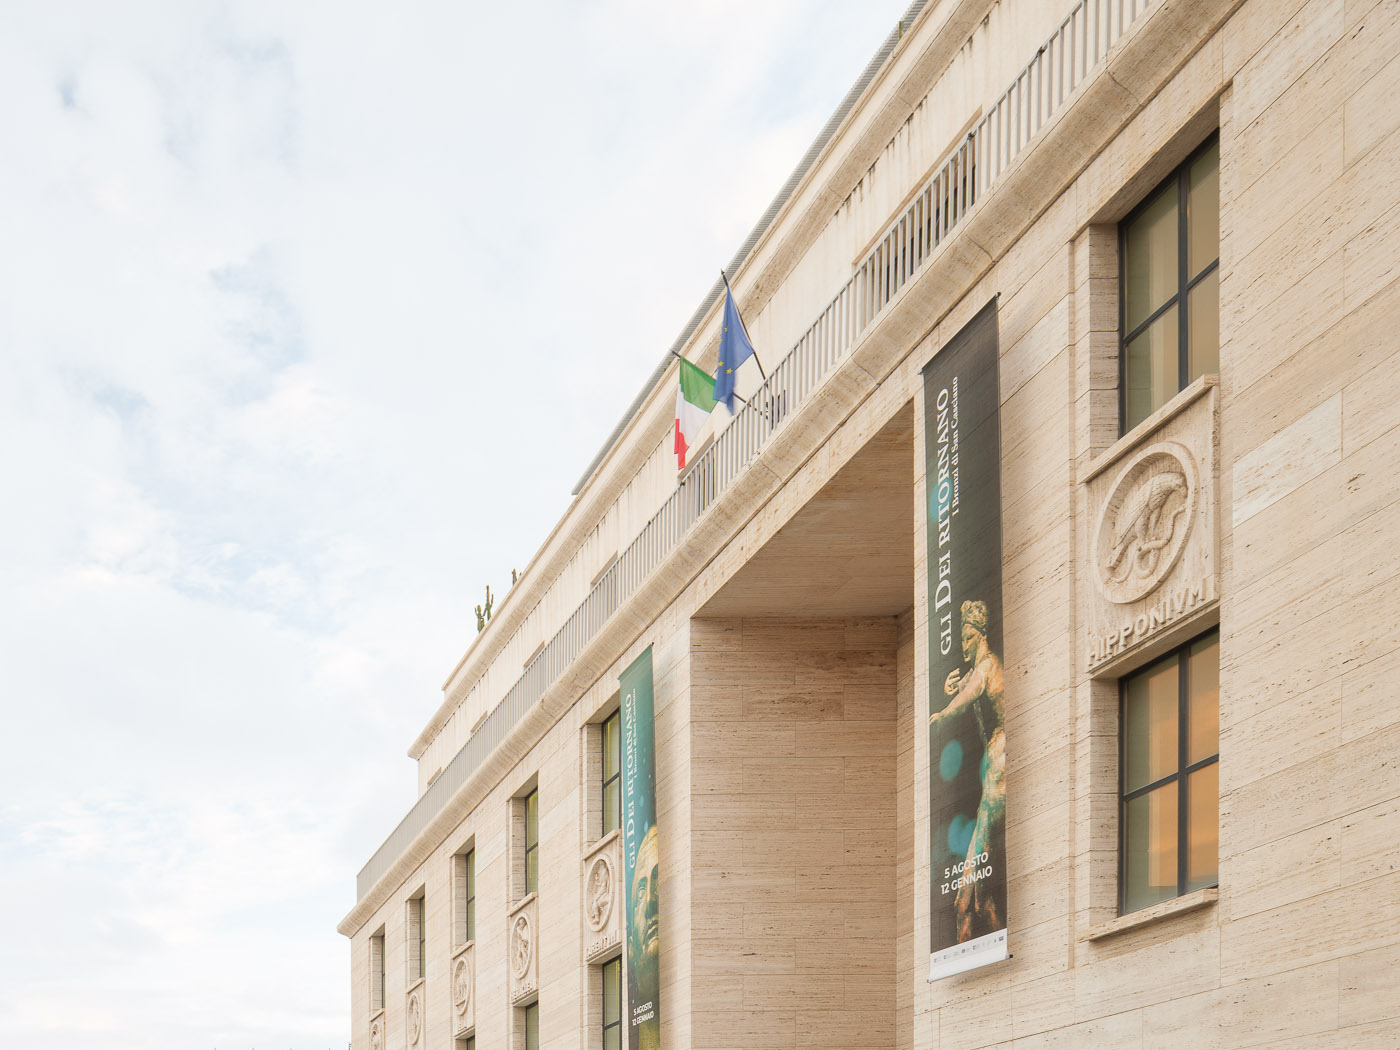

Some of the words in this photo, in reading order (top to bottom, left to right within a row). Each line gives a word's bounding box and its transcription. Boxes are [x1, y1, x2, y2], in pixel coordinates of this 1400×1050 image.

[950, 376, 959, 429] Casciano
[951, 429, 959, 453] San
[936, 387, 951, 549] RITORNANO
[951, 453, 959, 467] di
[951, 467, 960, 508] Bronzi
[940, 611, 952, 656] GLI
[625, 693, 635, 798] RITORNANO
[940, 882, 950, 895] 12
[951, 865, 993, 891] GENNAIO
[944, 867, 950, 879] 5
[951, 851, 989, 877] AGOSTO
[632, 1018, 637, 1027] 12
[637, 1010, 655, 1025] GENNAIO
[633, 1008, 637, 1016] 5
[637, 1001, 653, 1014] AGOSTO
